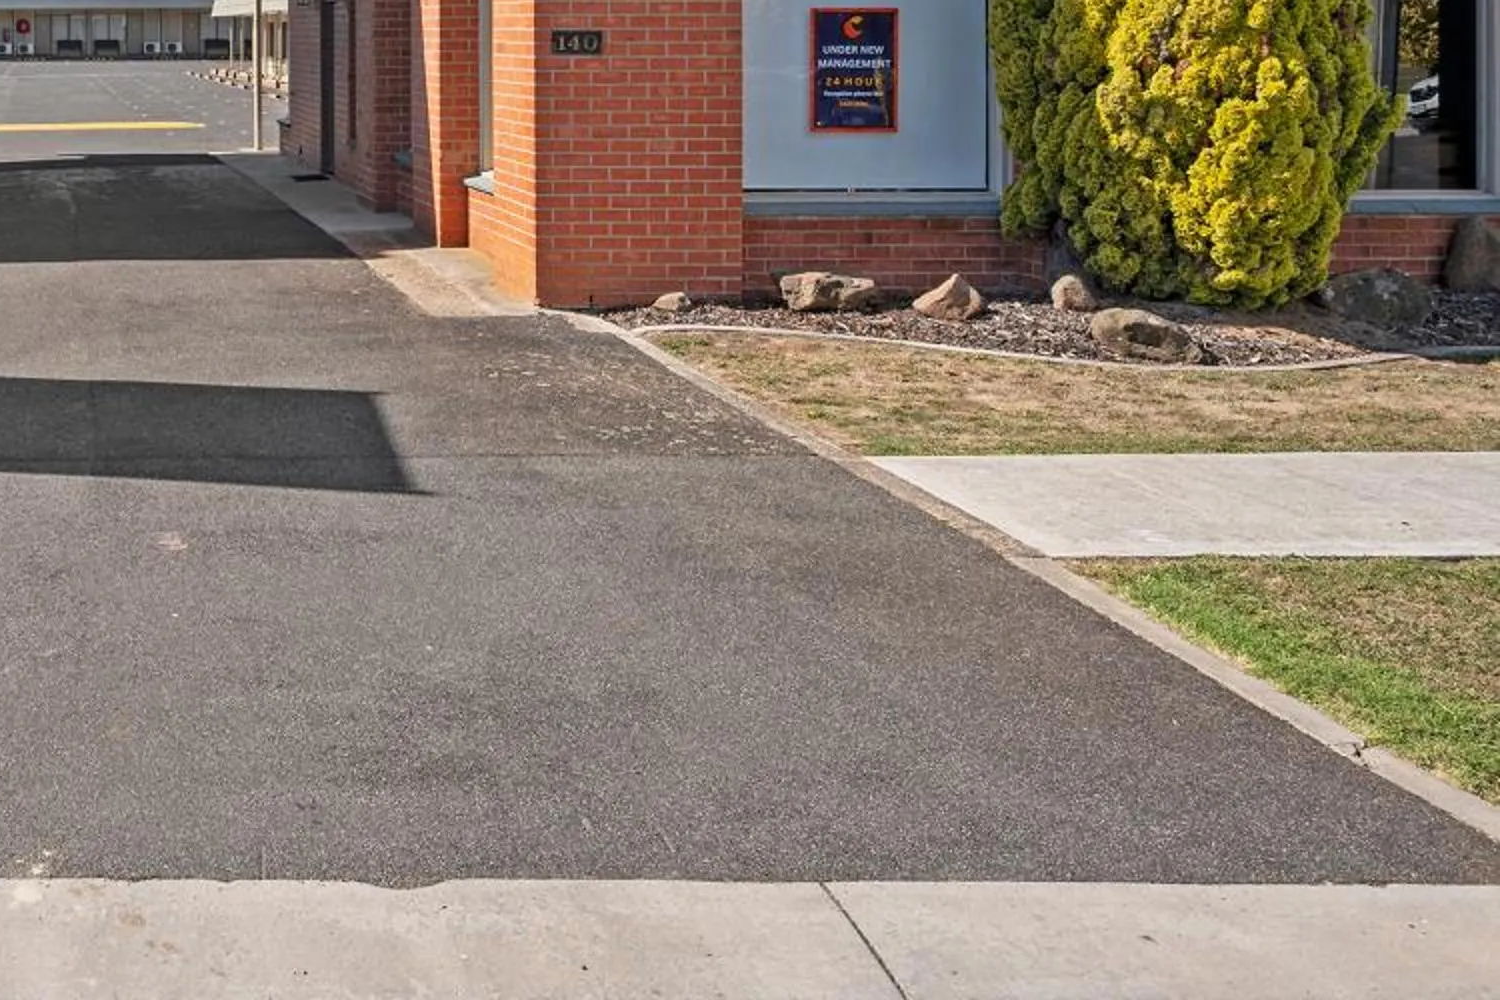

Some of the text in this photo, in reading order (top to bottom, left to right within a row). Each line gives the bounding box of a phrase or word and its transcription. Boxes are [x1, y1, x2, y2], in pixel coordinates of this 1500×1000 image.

[555, 34, 599, 53] 140
[822, 45, 885, 55] UNDER NEW
[817, 59, 891, 68] MANAGEMENT
